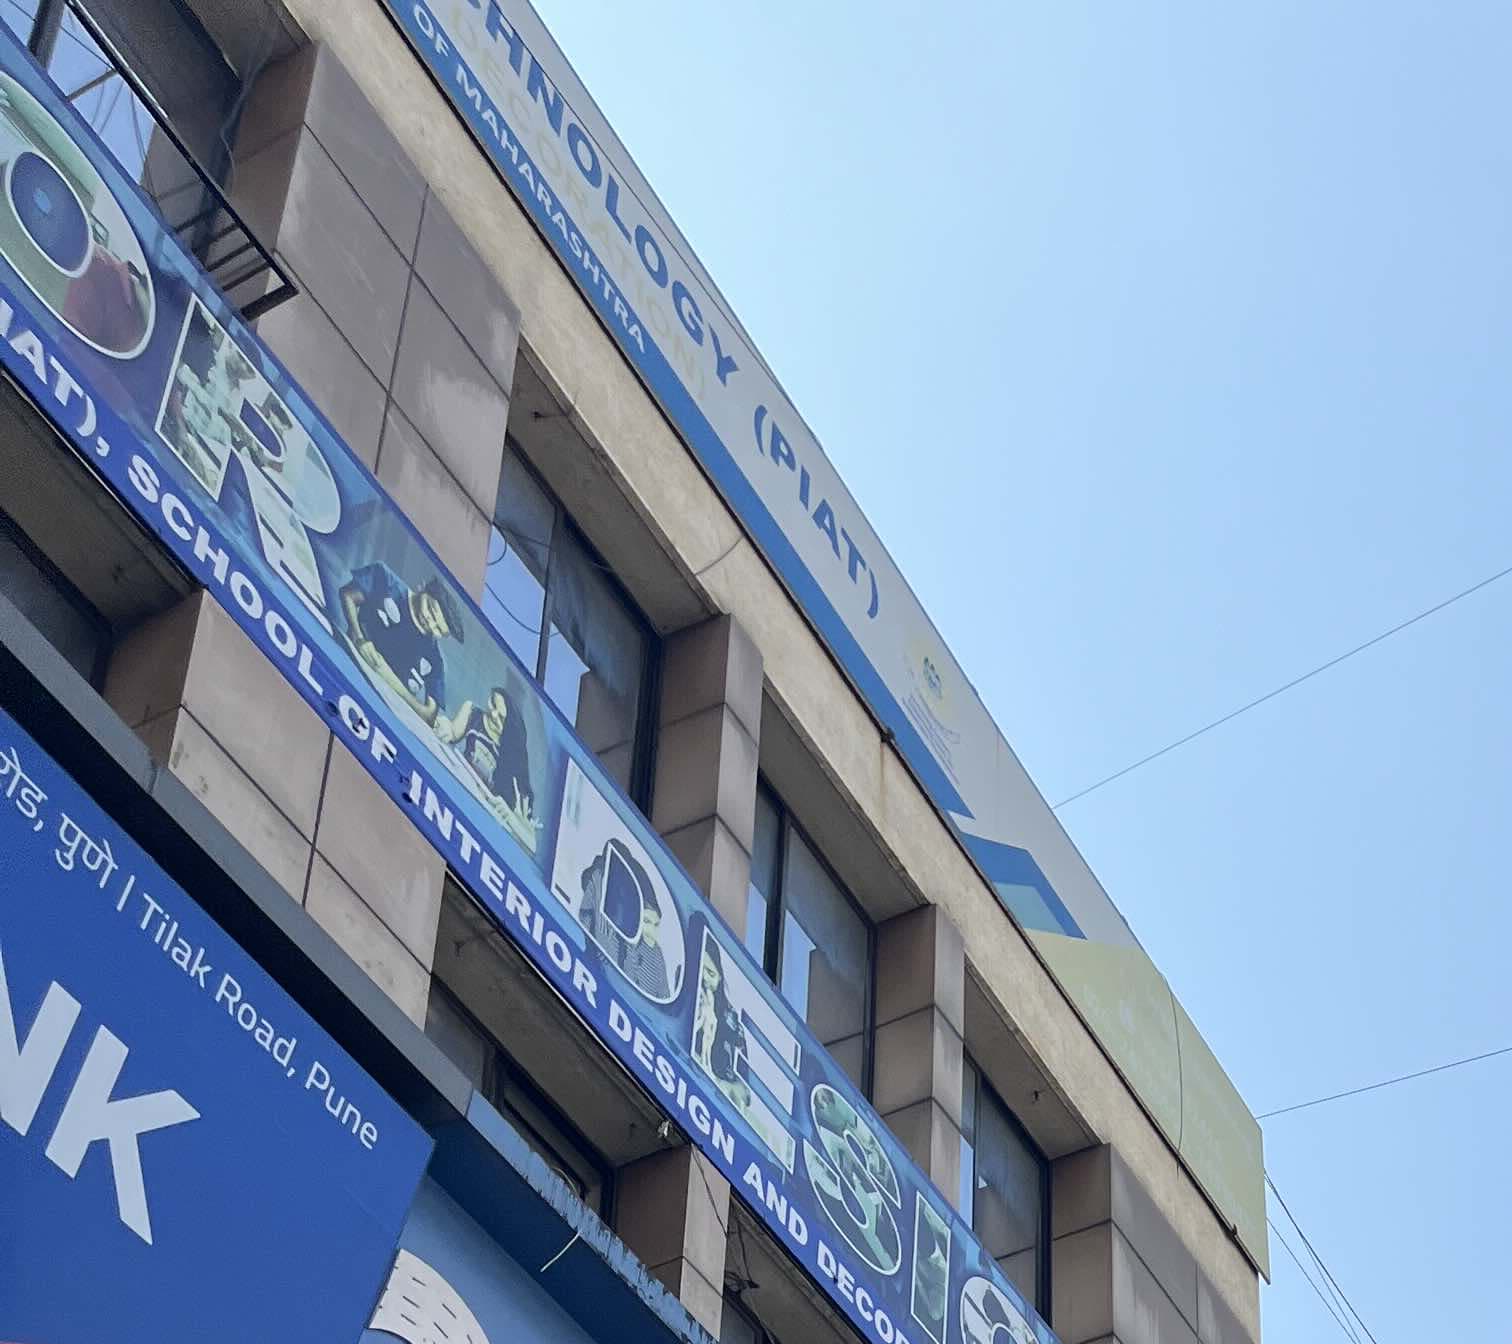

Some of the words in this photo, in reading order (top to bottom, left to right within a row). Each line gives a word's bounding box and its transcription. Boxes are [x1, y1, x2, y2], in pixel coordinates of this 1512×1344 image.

[413, 7, 450, 58] OF
[455, 65, 647, 355] MAHARASHTRA
[470, 0, 740, 387] HNOLOGY
[754, 404, 879, 620] (PIAT)
[0, 310, 110, 457] AT),
[127, 455, 323, 697] SCHOOL
[338, 694, 399, 765] OF
[409, 770, 599, 1010] INTERIOR
[607, 996, 736, 1170] DESIGN
[741, 1160, 809, 1252] AND
[55, 812, 119, 889] पुणे
[138, 892, 213, 989] Tilak
[214, 974, 297, 1077] Road,
[304, 1059, 380, 1151] Pune
